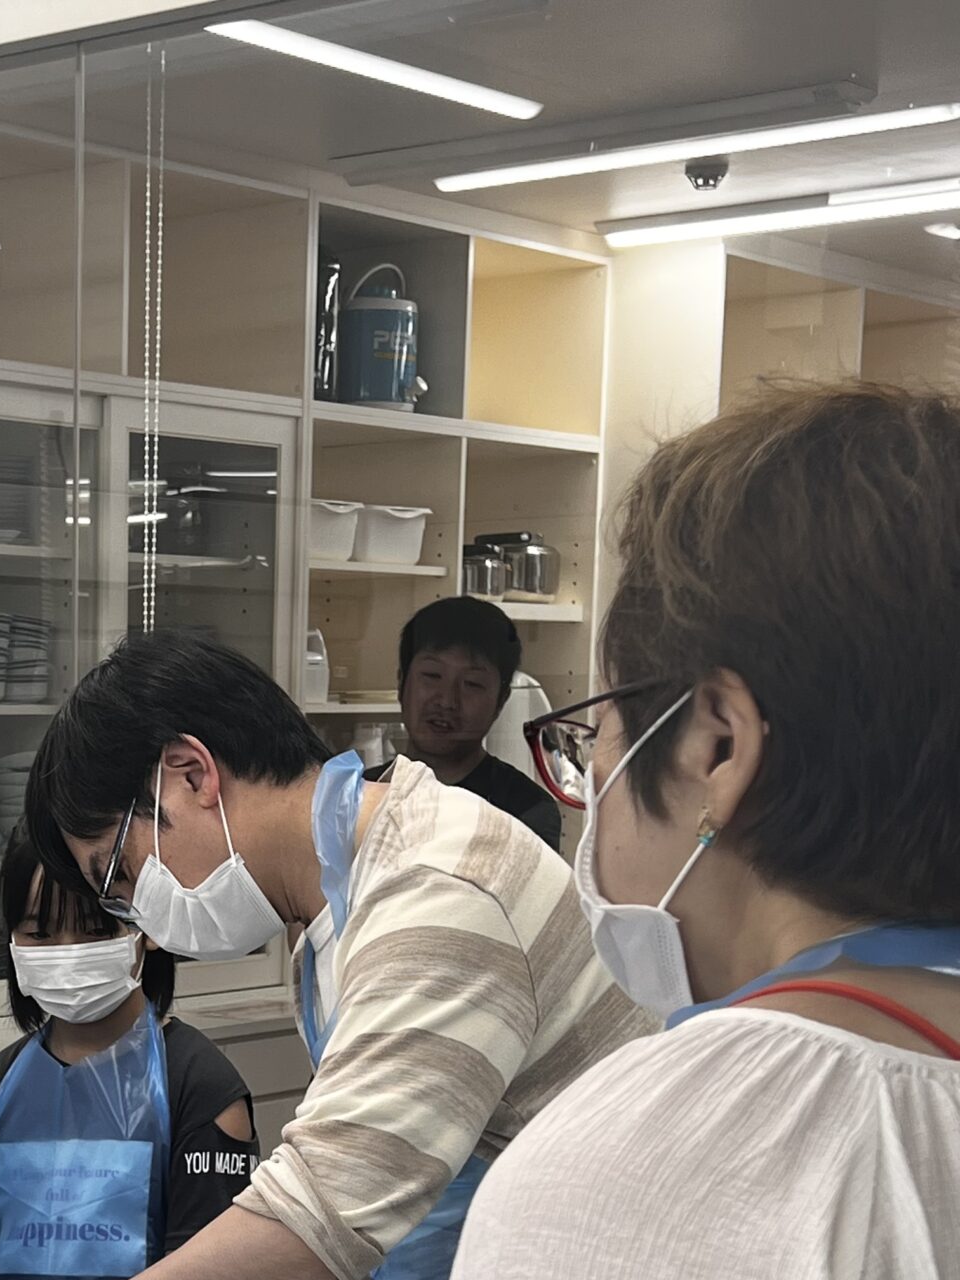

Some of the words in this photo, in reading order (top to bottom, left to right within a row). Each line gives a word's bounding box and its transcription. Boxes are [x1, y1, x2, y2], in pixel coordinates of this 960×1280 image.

[184, 1151, 210, 1174] YOU
[215, 1151, 247, 1175] MADE
[9, 1215, 131, 1248] ppiness.
